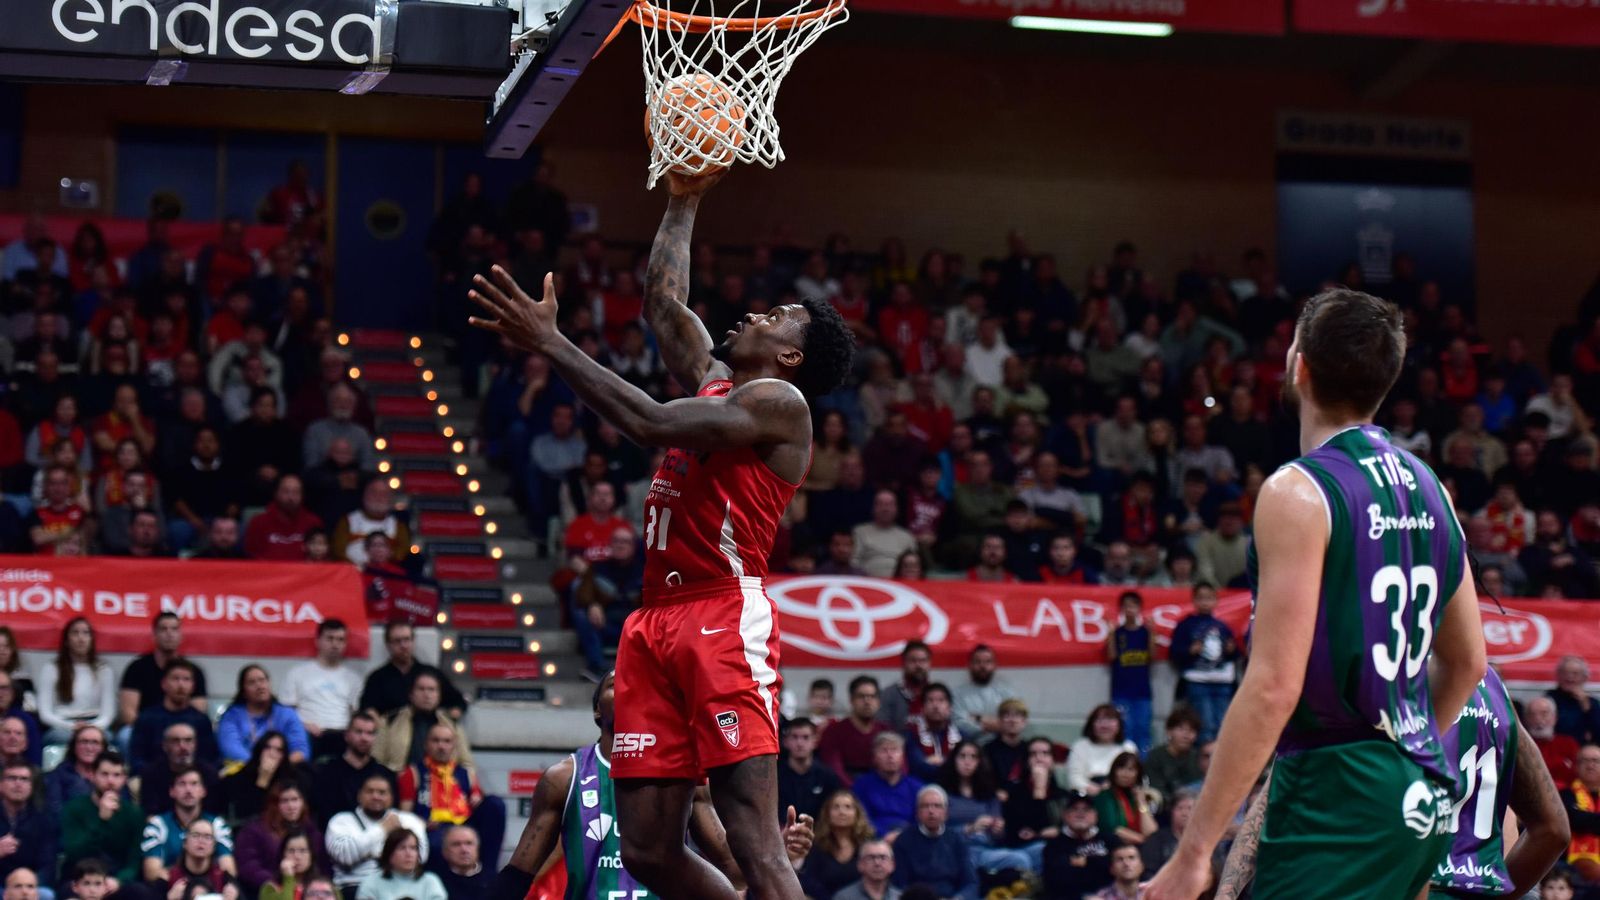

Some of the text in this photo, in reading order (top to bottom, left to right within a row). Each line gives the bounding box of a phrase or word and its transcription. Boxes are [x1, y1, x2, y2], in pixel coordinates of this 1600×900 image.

[51, 0, 382, 64] endesa
[646, 505, 672, 551] 31
[0, 582, 324, 624] IÓN DE MURCIA
[1370, 565, 1439, 681] 33
[720, 717, 734, 726] acb
[1448, 744, 1498, 840] 11
